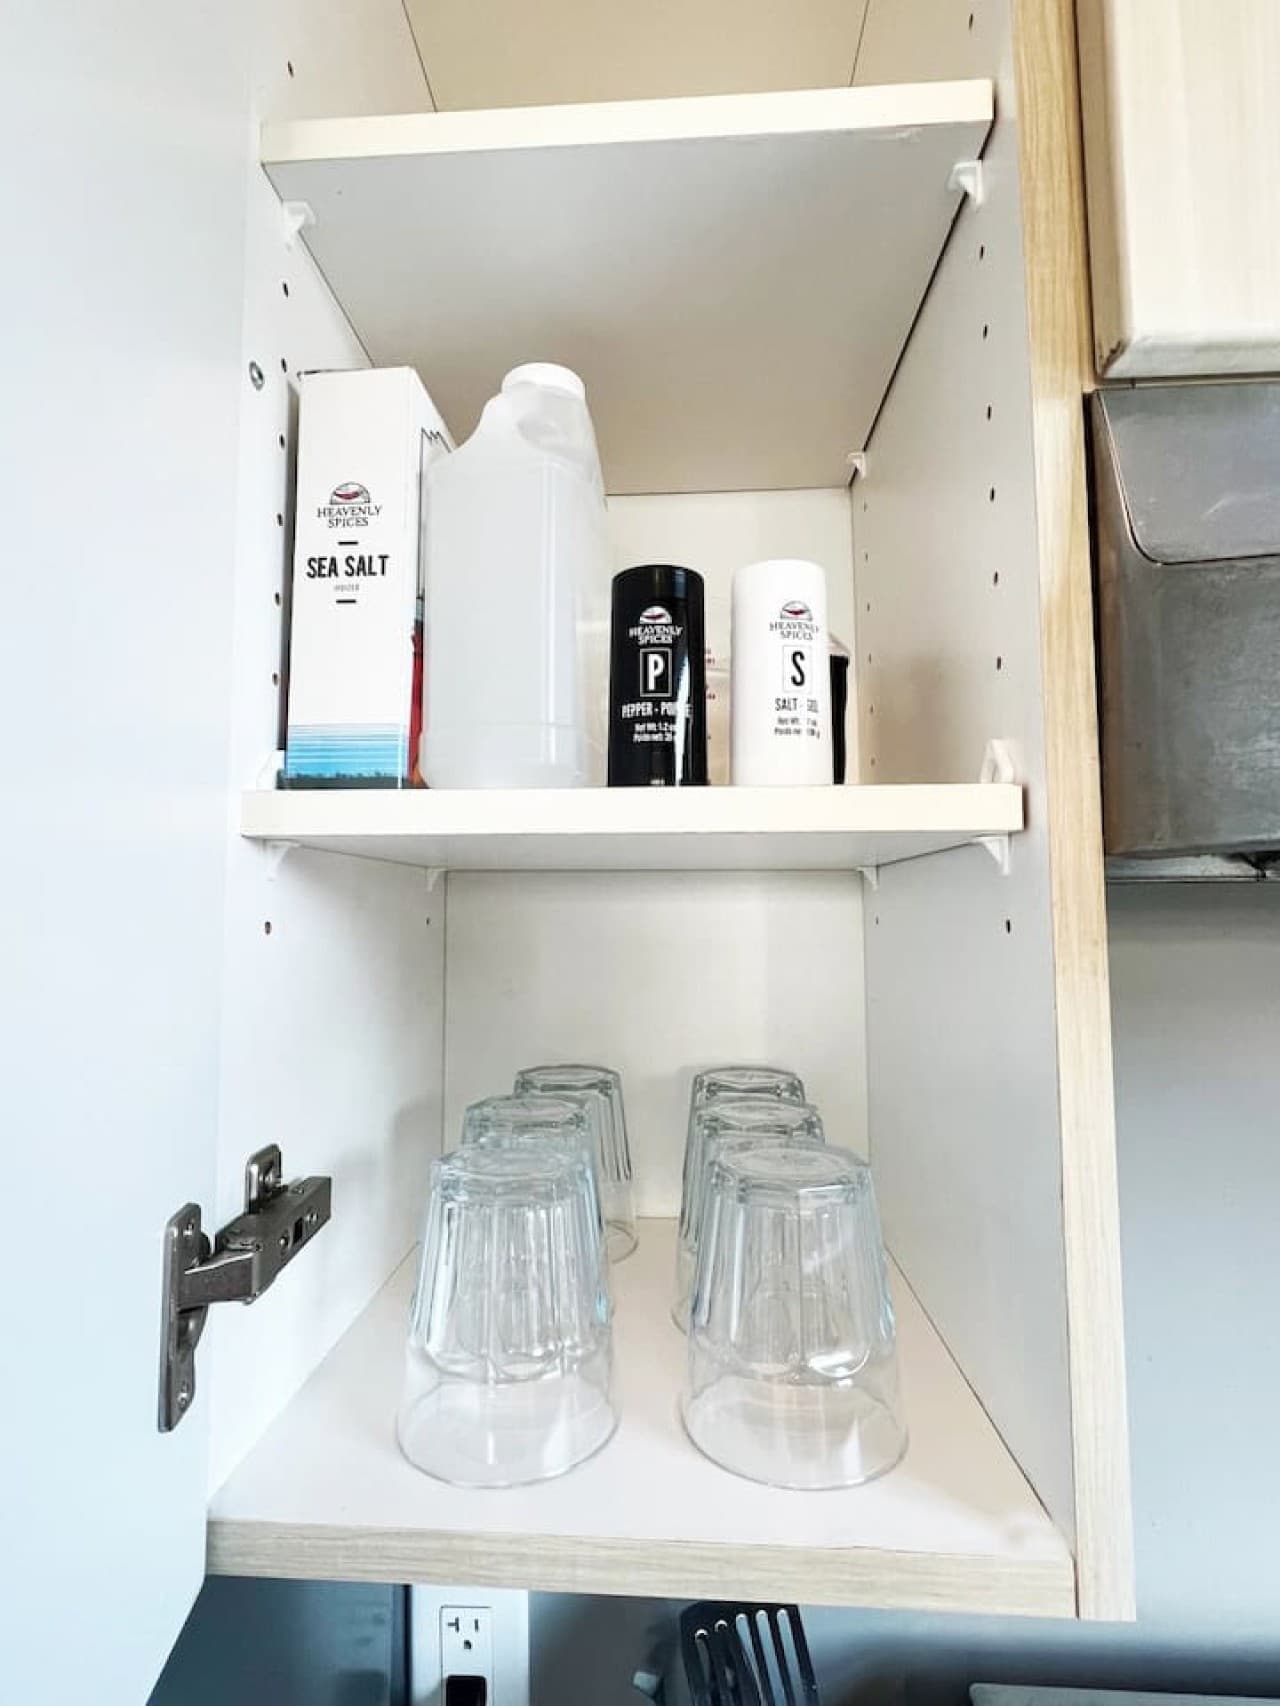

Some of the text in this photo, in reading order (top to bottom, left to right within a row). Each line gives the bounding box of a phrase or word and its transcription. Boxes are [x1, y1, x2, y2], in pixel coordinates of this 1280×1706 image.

[317, 505, 382, 518] HEAVENLY
[328, 516, 369, 528] SPICES
[306, 554, 390, 579] SEA SALT
[629, 624, 683, 638] HEAVENLY
[769, 620, 819, 634] HEAVENLY
[648, 653, 665, 691] P
[791, 651, 805, 687] S
[621, 701, 653, 719] PEPPER
[775, 697, 798, 711] SALT
